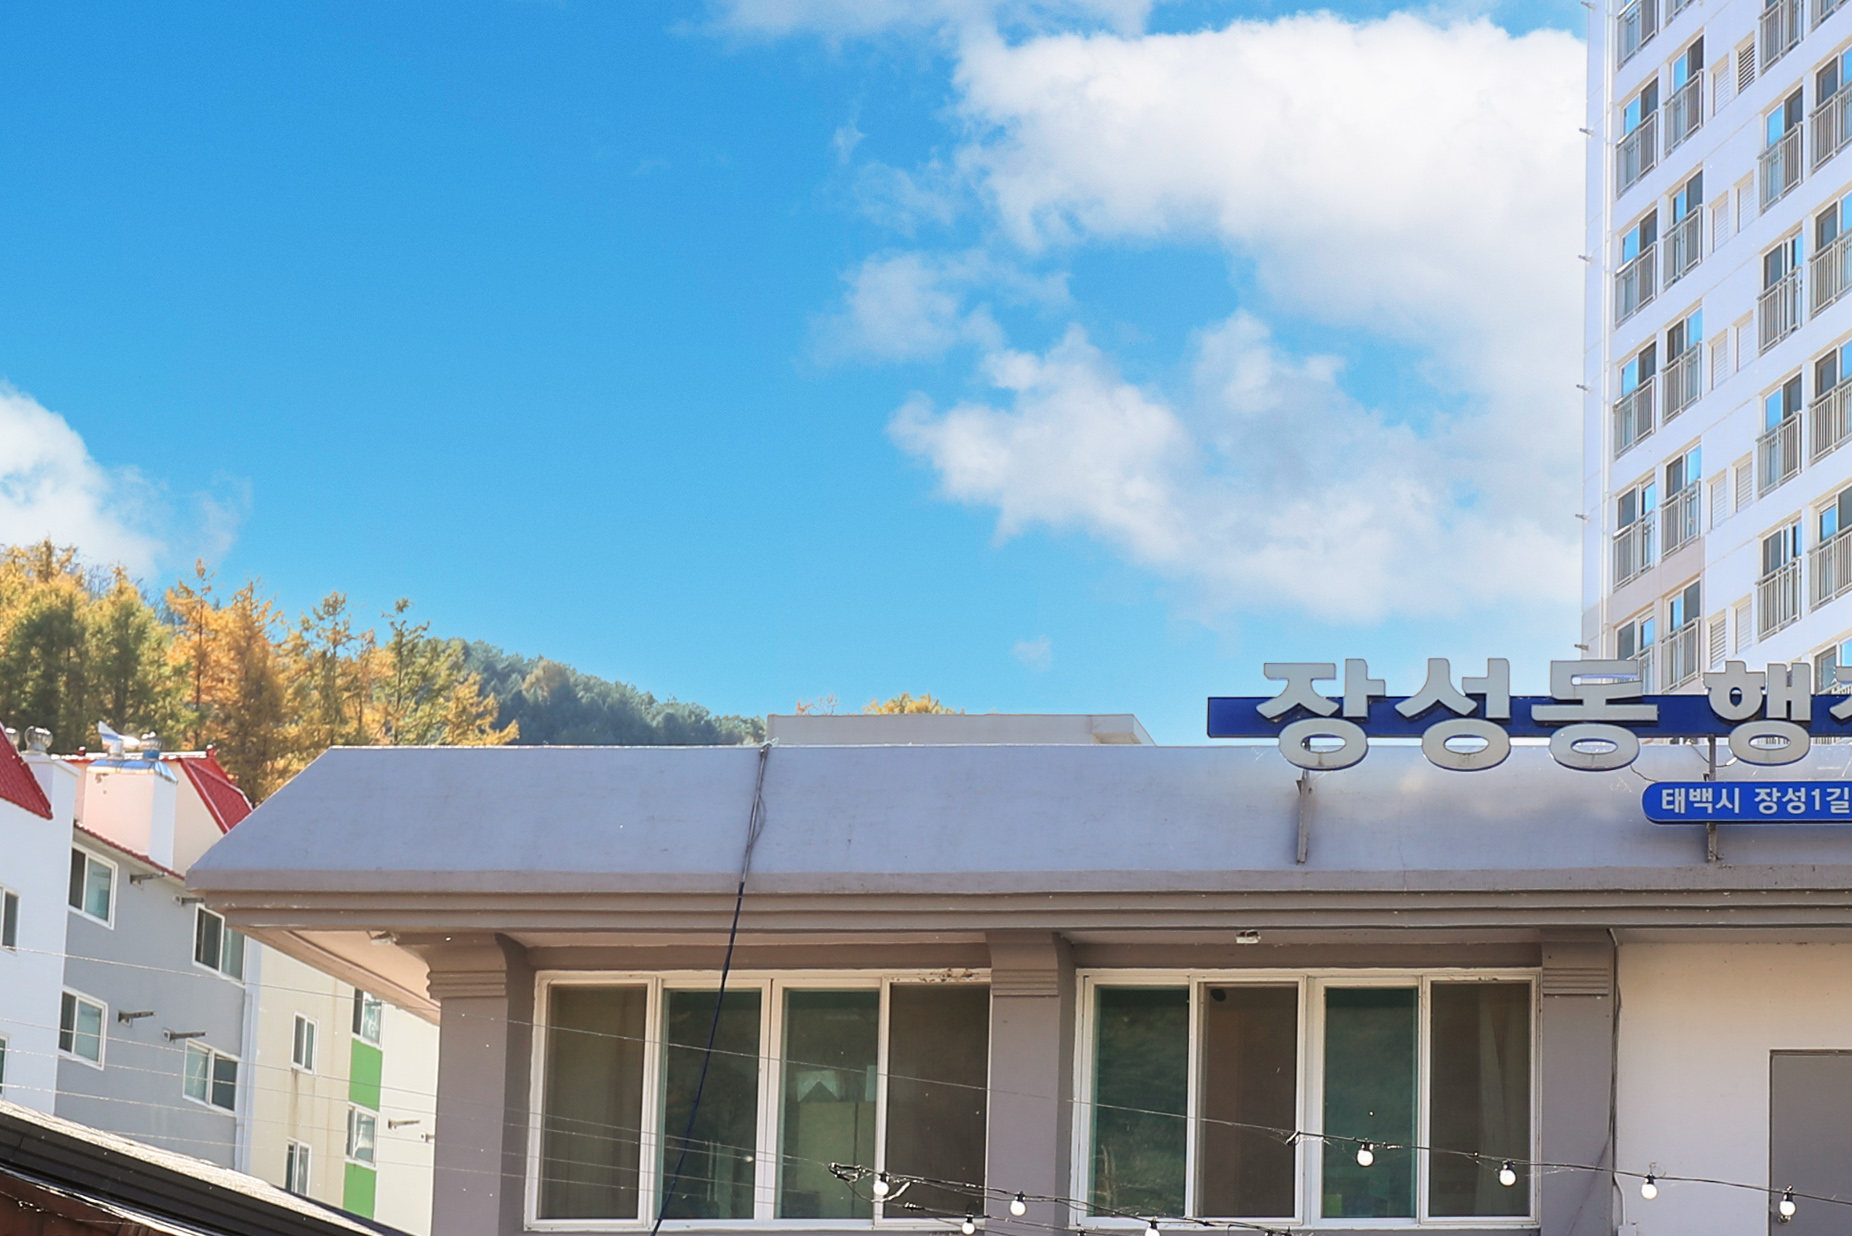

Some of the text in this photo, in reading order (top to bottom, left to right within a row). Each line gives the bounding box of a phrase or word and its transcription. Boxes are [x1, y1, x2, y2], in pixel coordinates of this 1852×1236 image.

[1255, 657, 1659, 772] 장성동
[1661, 787, 1740, 815] 태백시
[1754, 787, 1850, 814] 장성1길
